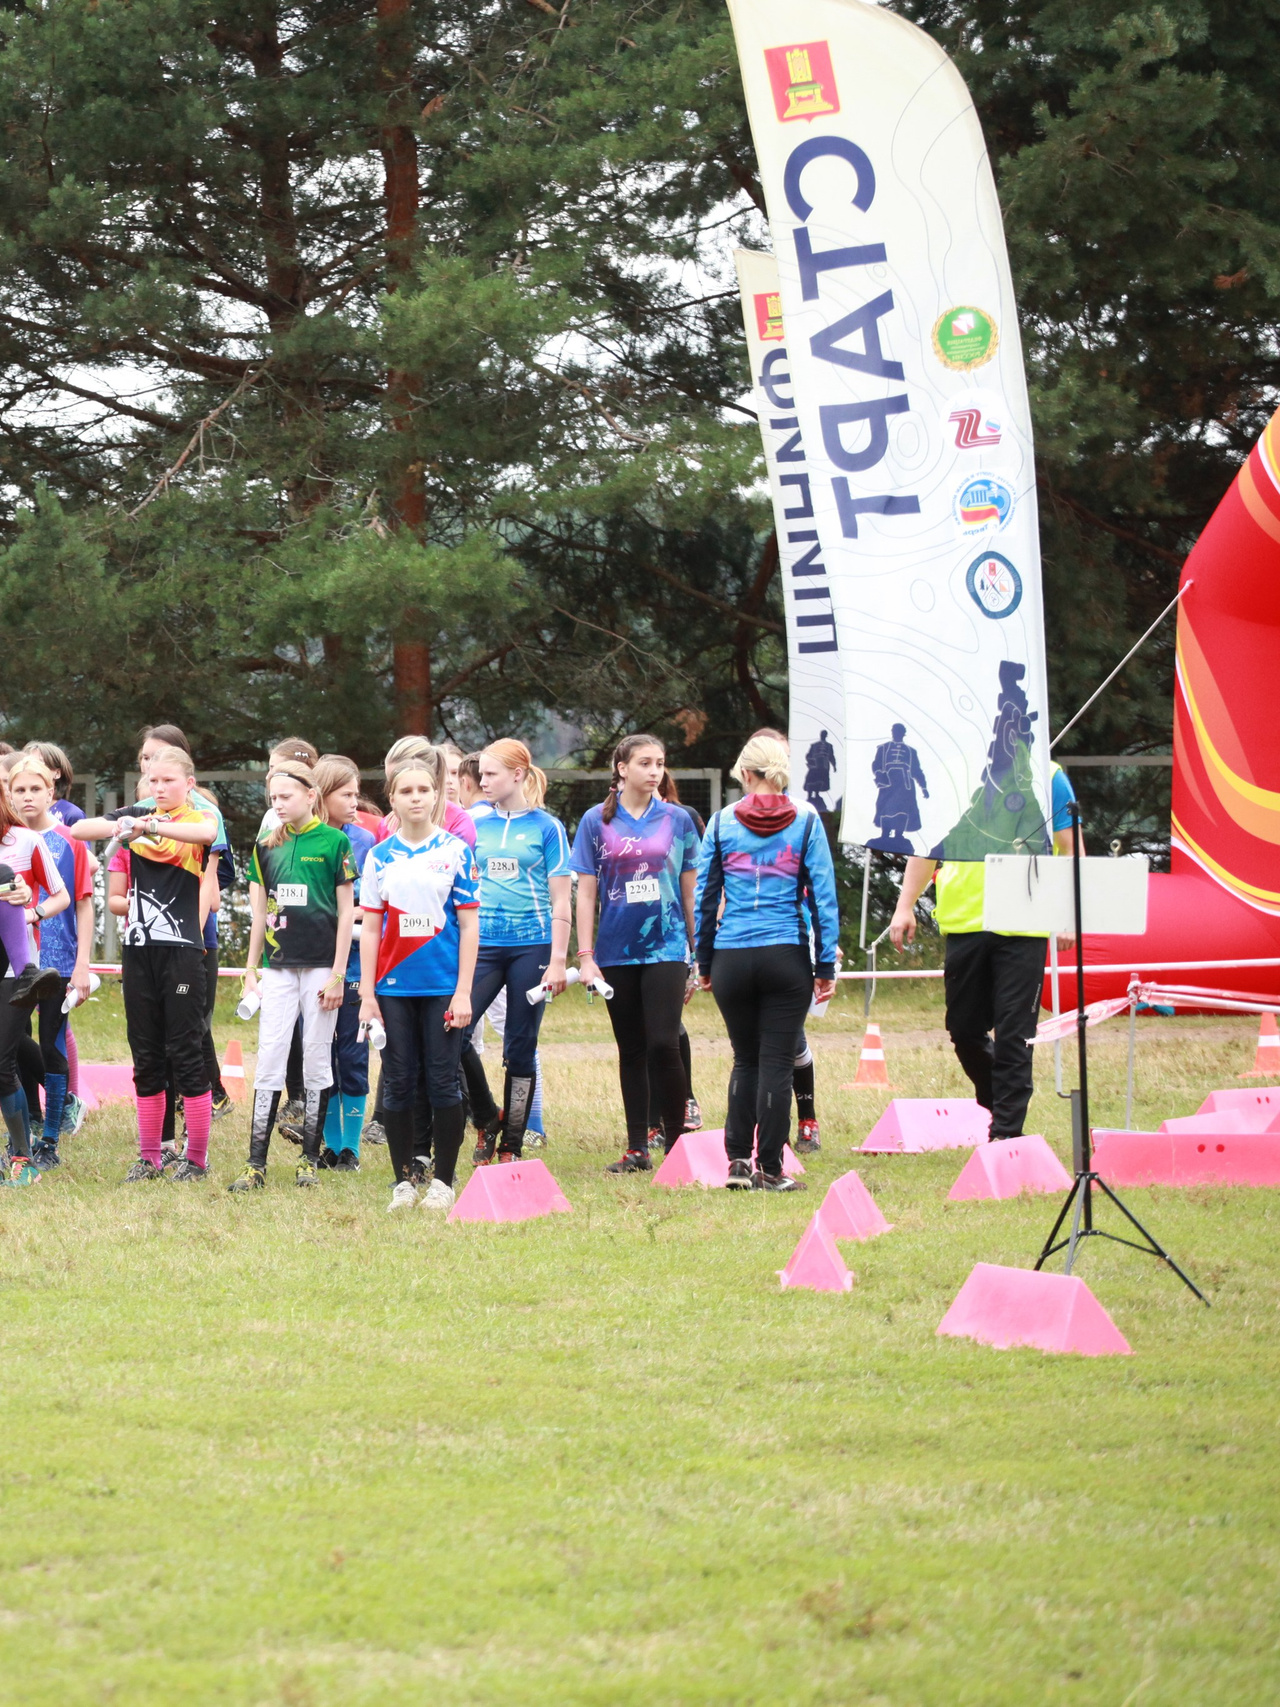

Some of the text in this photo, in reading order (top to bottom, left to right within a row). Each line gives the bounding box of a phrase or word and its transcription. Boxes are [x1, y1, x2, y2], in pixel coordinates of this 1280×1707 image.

[491, 861, 515, 871] 228.1
[280, 887, 304, 898] 218.1
[630, 883, 656, 895] 229.1
[403, 918, 431, 928] 209.1
